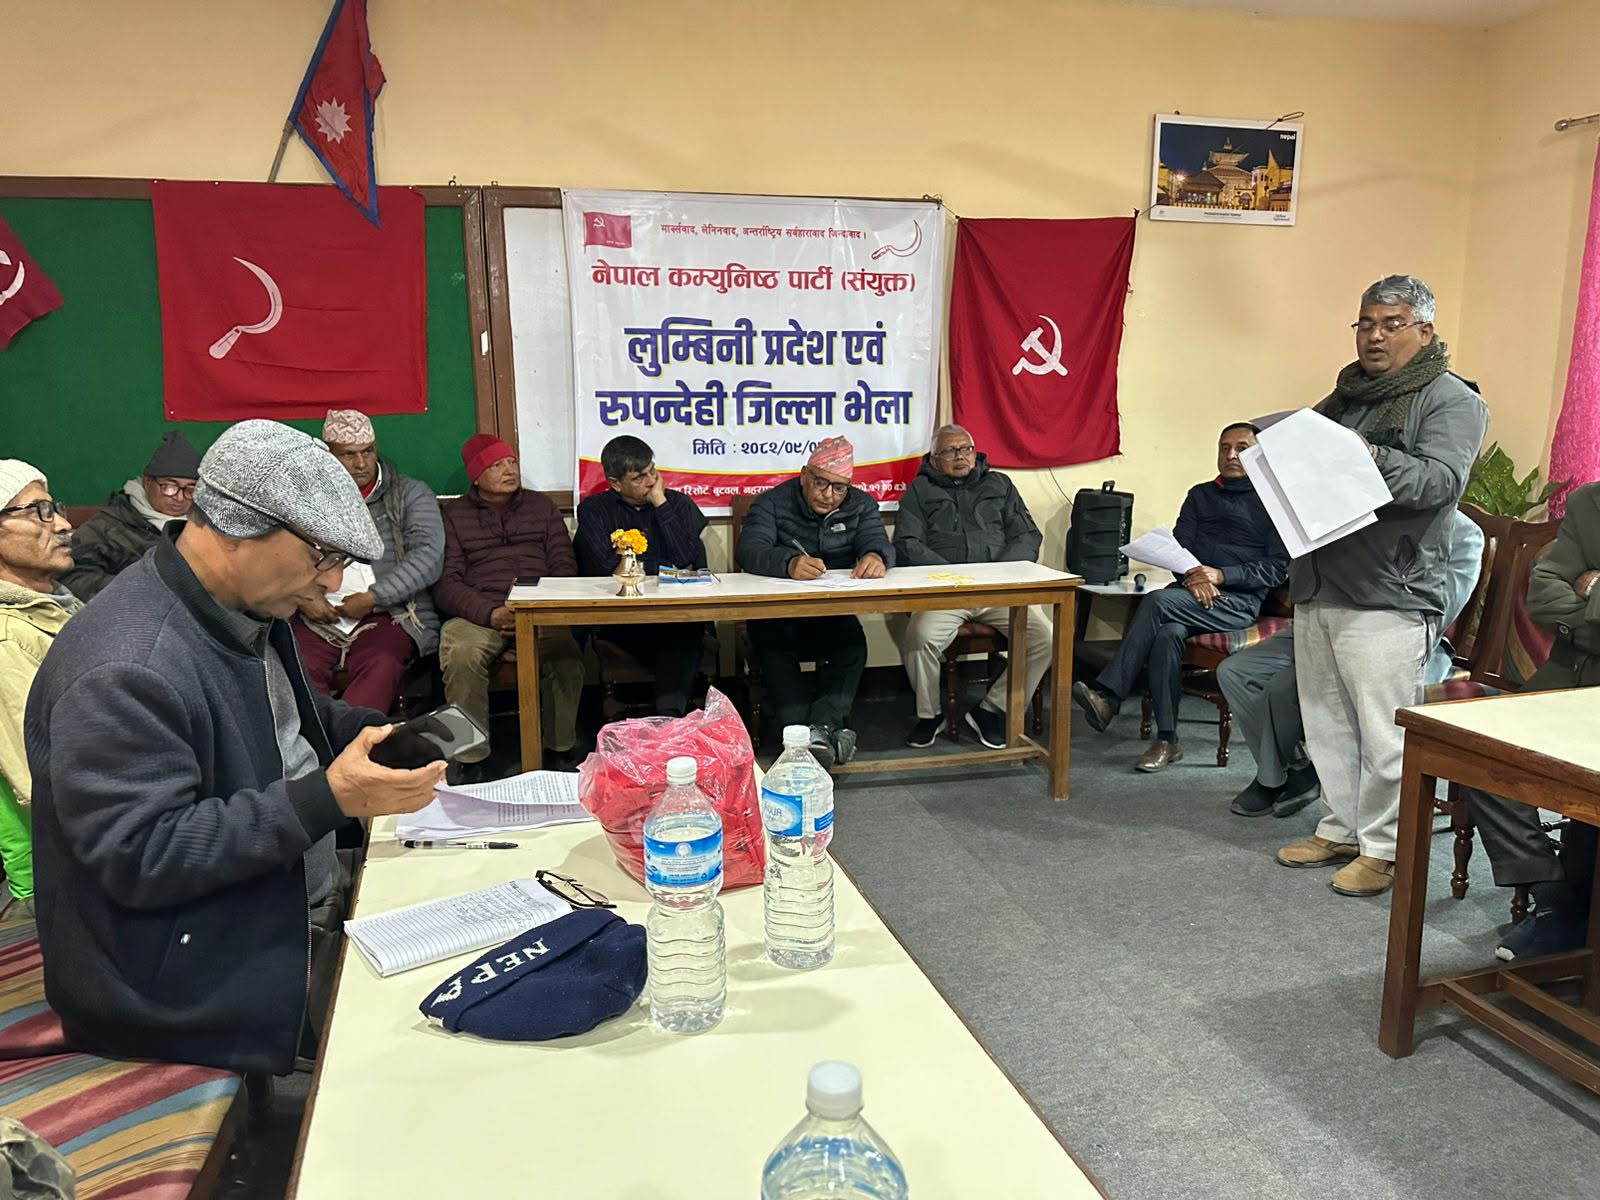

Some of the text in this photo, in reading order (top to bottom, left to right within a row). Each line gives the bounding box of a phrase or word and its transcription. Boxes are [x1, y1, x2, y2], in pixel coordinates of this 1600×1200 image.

[591, 259, 661, 286] नेपाल
[788, 265, 833, 290] पार्टी
[841, 268, 916, 296] (संयुक्त)
[624, 316, 887, 377] लुम्बिनी प्रदेश एवं
[595, 379, 913, 427] रुपन्देही जिल्ला भेला
[692, 438, 727, 455] मिति
[740, 439, 820, 456] २०८२/०९/०
